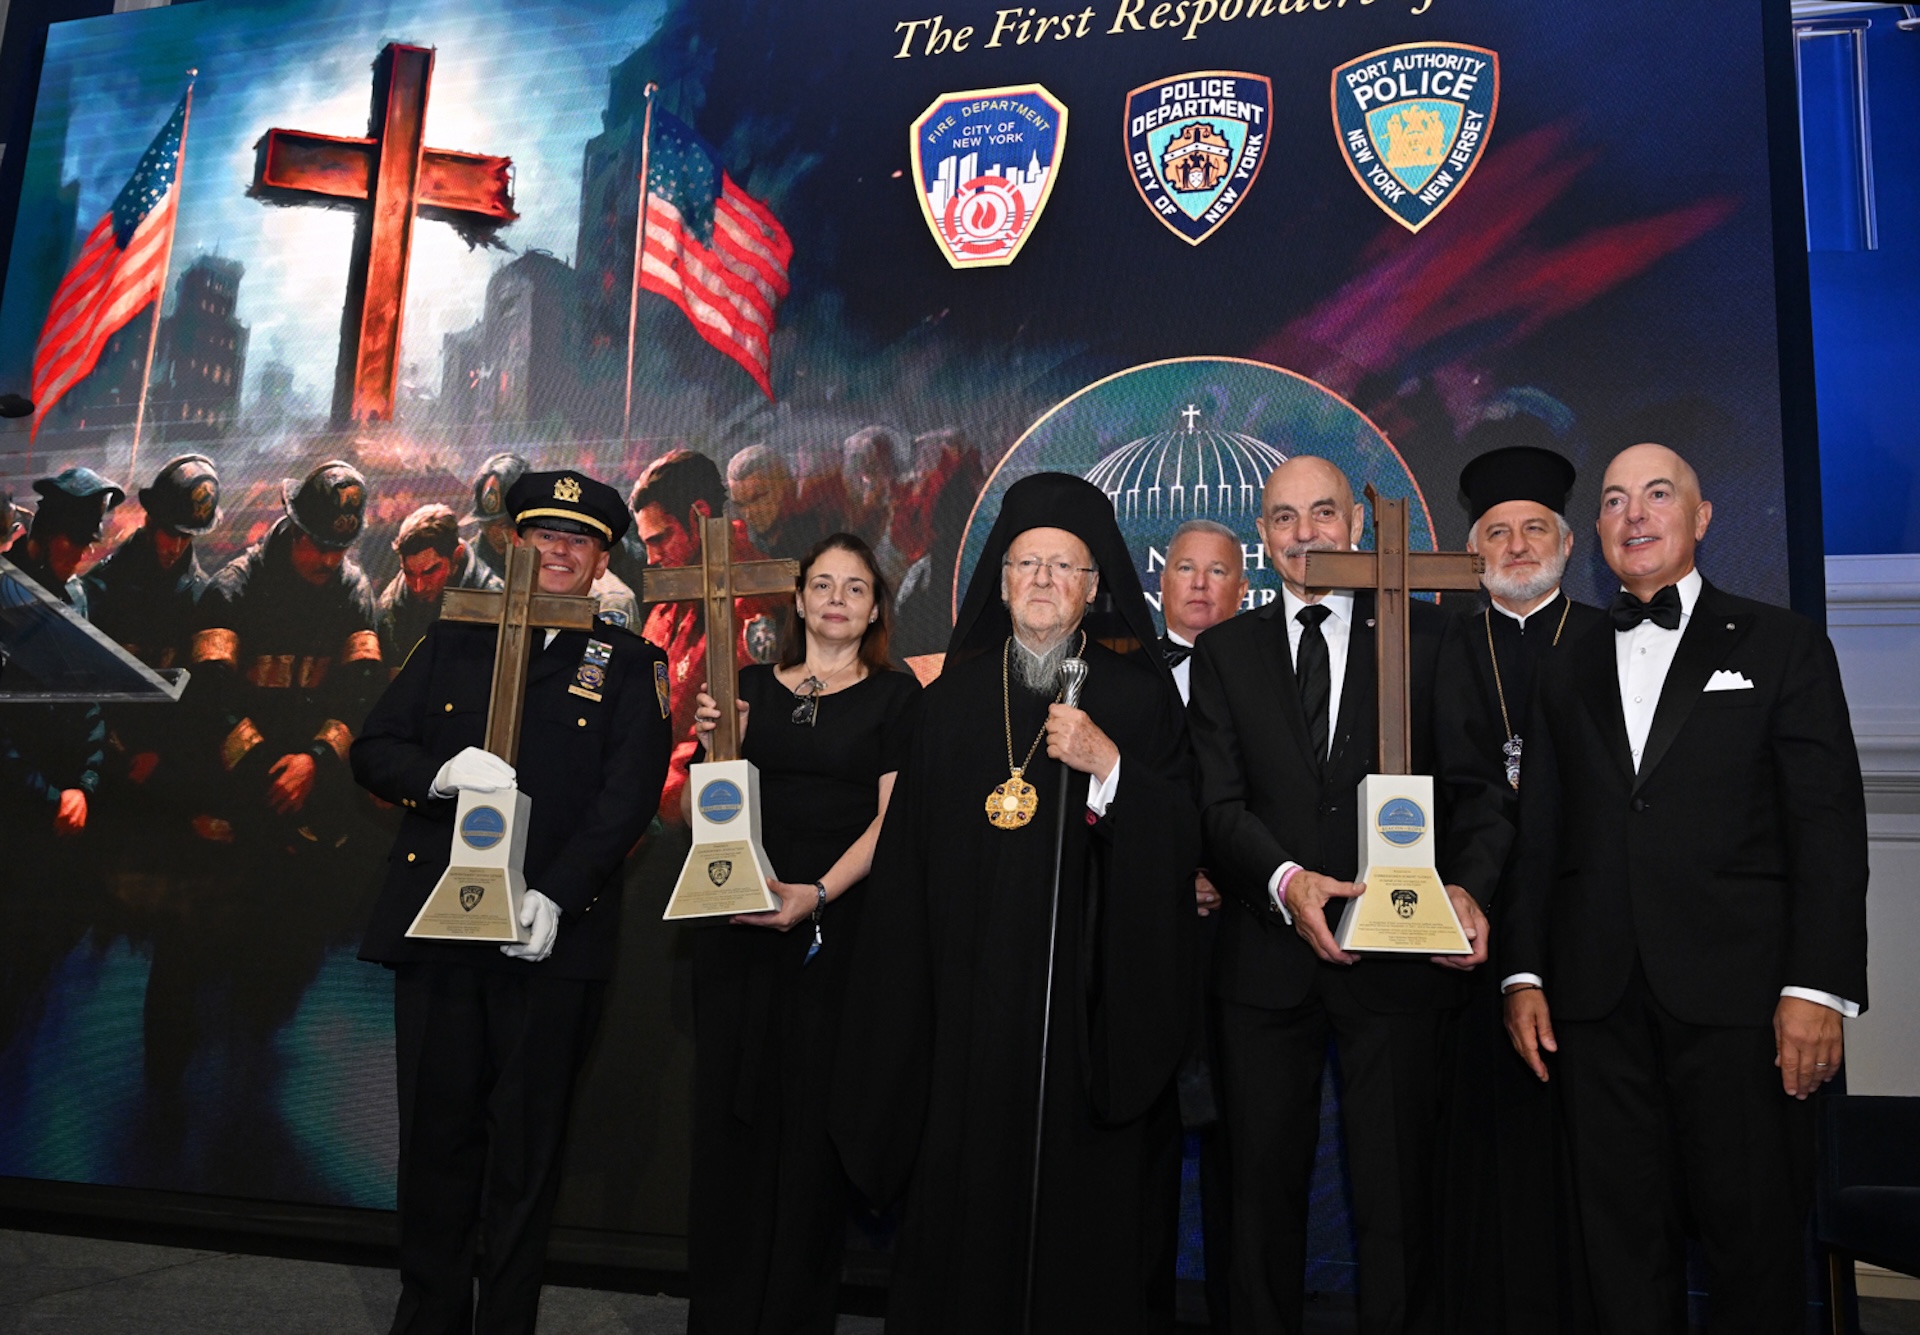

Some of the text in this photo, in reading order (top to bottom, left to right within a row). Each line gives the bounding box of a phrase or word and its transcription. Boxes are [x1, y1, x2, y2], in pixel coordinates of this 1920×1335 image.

[893, 15, 974, 59] The
[983, 6, 1096, 49] First
[1345, 53, 1486, 88] PORT AUTHORITY
[1353, 70, 1478, 111] POLICE
[1160, 79, 1236, 105] POLICE
[928, 100, 1050, 144] FIRE DEPARTMENT
[962, 121, 1016, 136] CITY OF
[1131, 98, 1264, 138] DEPARTMENT
[952, 132, 1024, 149] NEW YORK
[1418, 109, 1485, 206] NEW JERSEY
[1133, 151, 1177, 215] CITY OF
[1204, 133, 1264, 224] NEW YORK
[1347, 128, 1407, 204] NEW YORK
